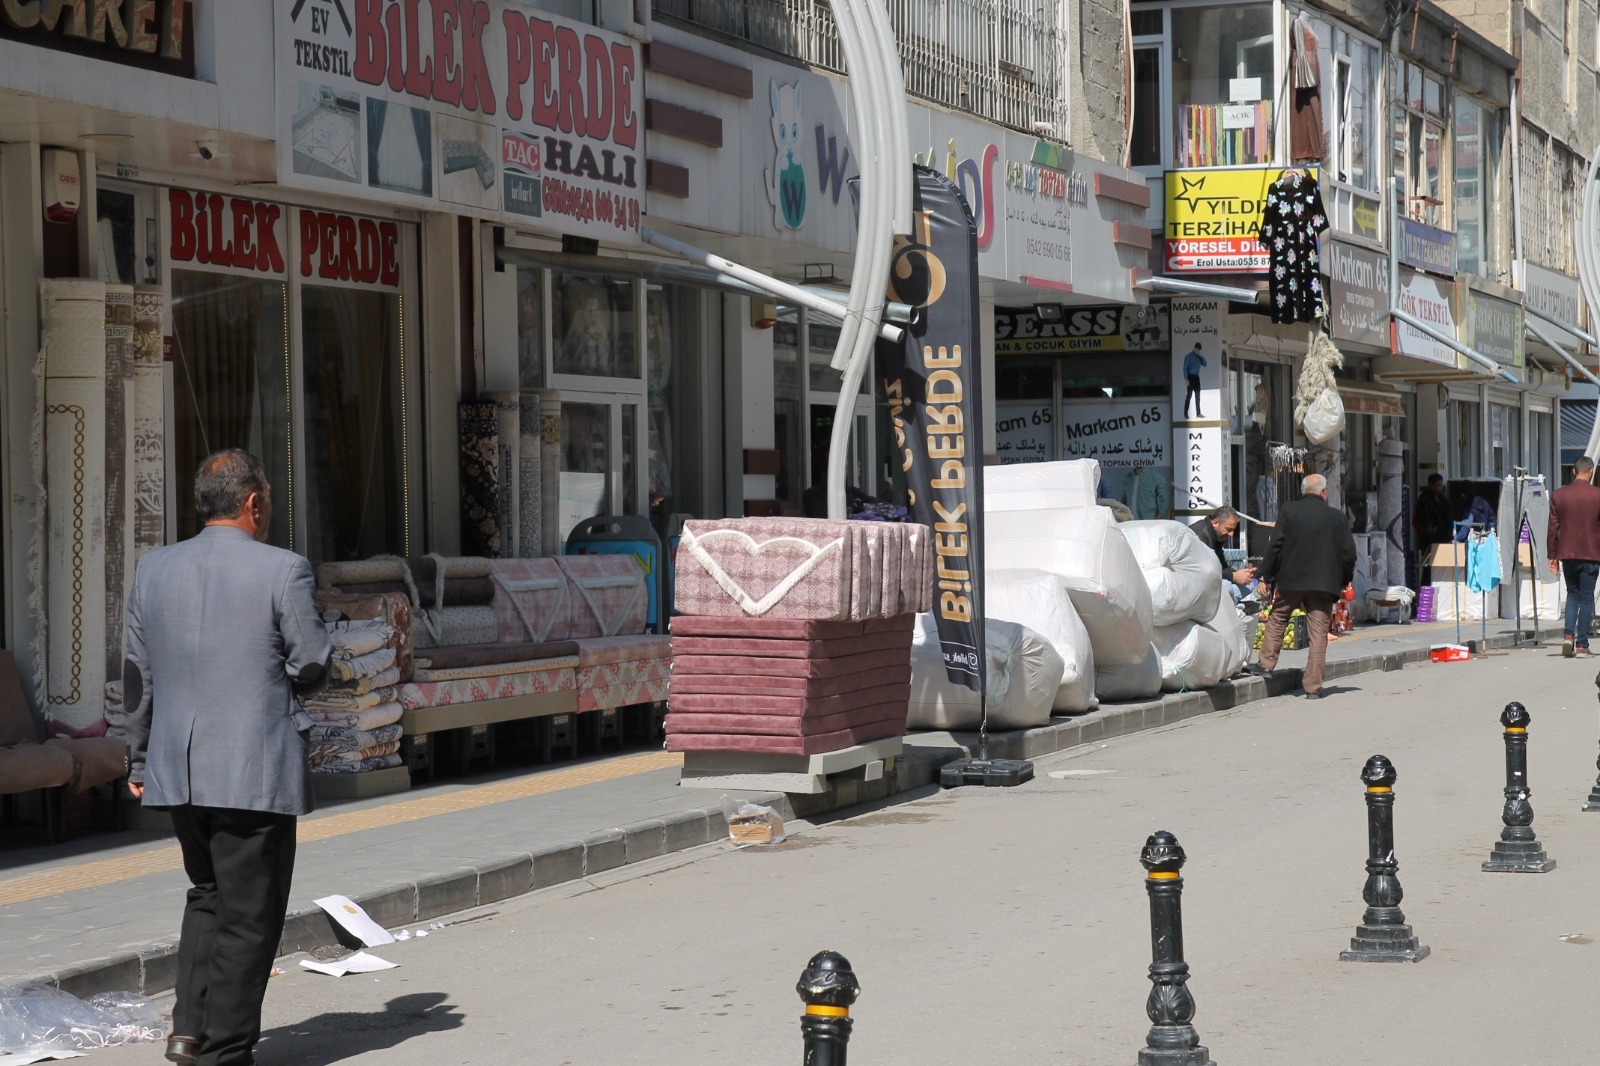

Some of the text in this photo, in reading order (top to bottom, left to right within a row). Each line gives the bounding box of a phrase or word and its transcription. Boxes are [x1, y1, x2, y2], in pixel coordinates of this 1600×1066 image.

[311, 6, 330, 36] EV
[503, 9, 637, 150] PERDE
[543, 136, 637, 188] HALI
[614, 194, 627, 231] 34
[782, 179, 804, 222] W
[299, 209, 400, 287] PERDE
[1026, 238, 1042, 256] 0542
[1169, 240, 1236, 254] YÖRESEL
[1197, 258, 1213, 267] Erol
[1216, 257, 1259, 267] Usta:0535
[1330, 244, 1388, 293] Markam 65
[1173, 301, 1218, 311] MARKAM
[1401, 290, 1417, 317] GÖK
[1188, 314, 1202, 324] 65
[1014, 342, 1022, 351] &
[1026, 340, 1065, 353] ÇOCUK
[1069, 337, 1102, 348] GİYİM
[1032, 408, 1052, 426] 65
[1066, 407, 1162, 440] Markam 65
[1067, 438, 1163, 460] پوشاک عمده مردانه
[1133, 459, 1155, 467] GİYİM
[1189, 433, 1203, 494] MARKAM
